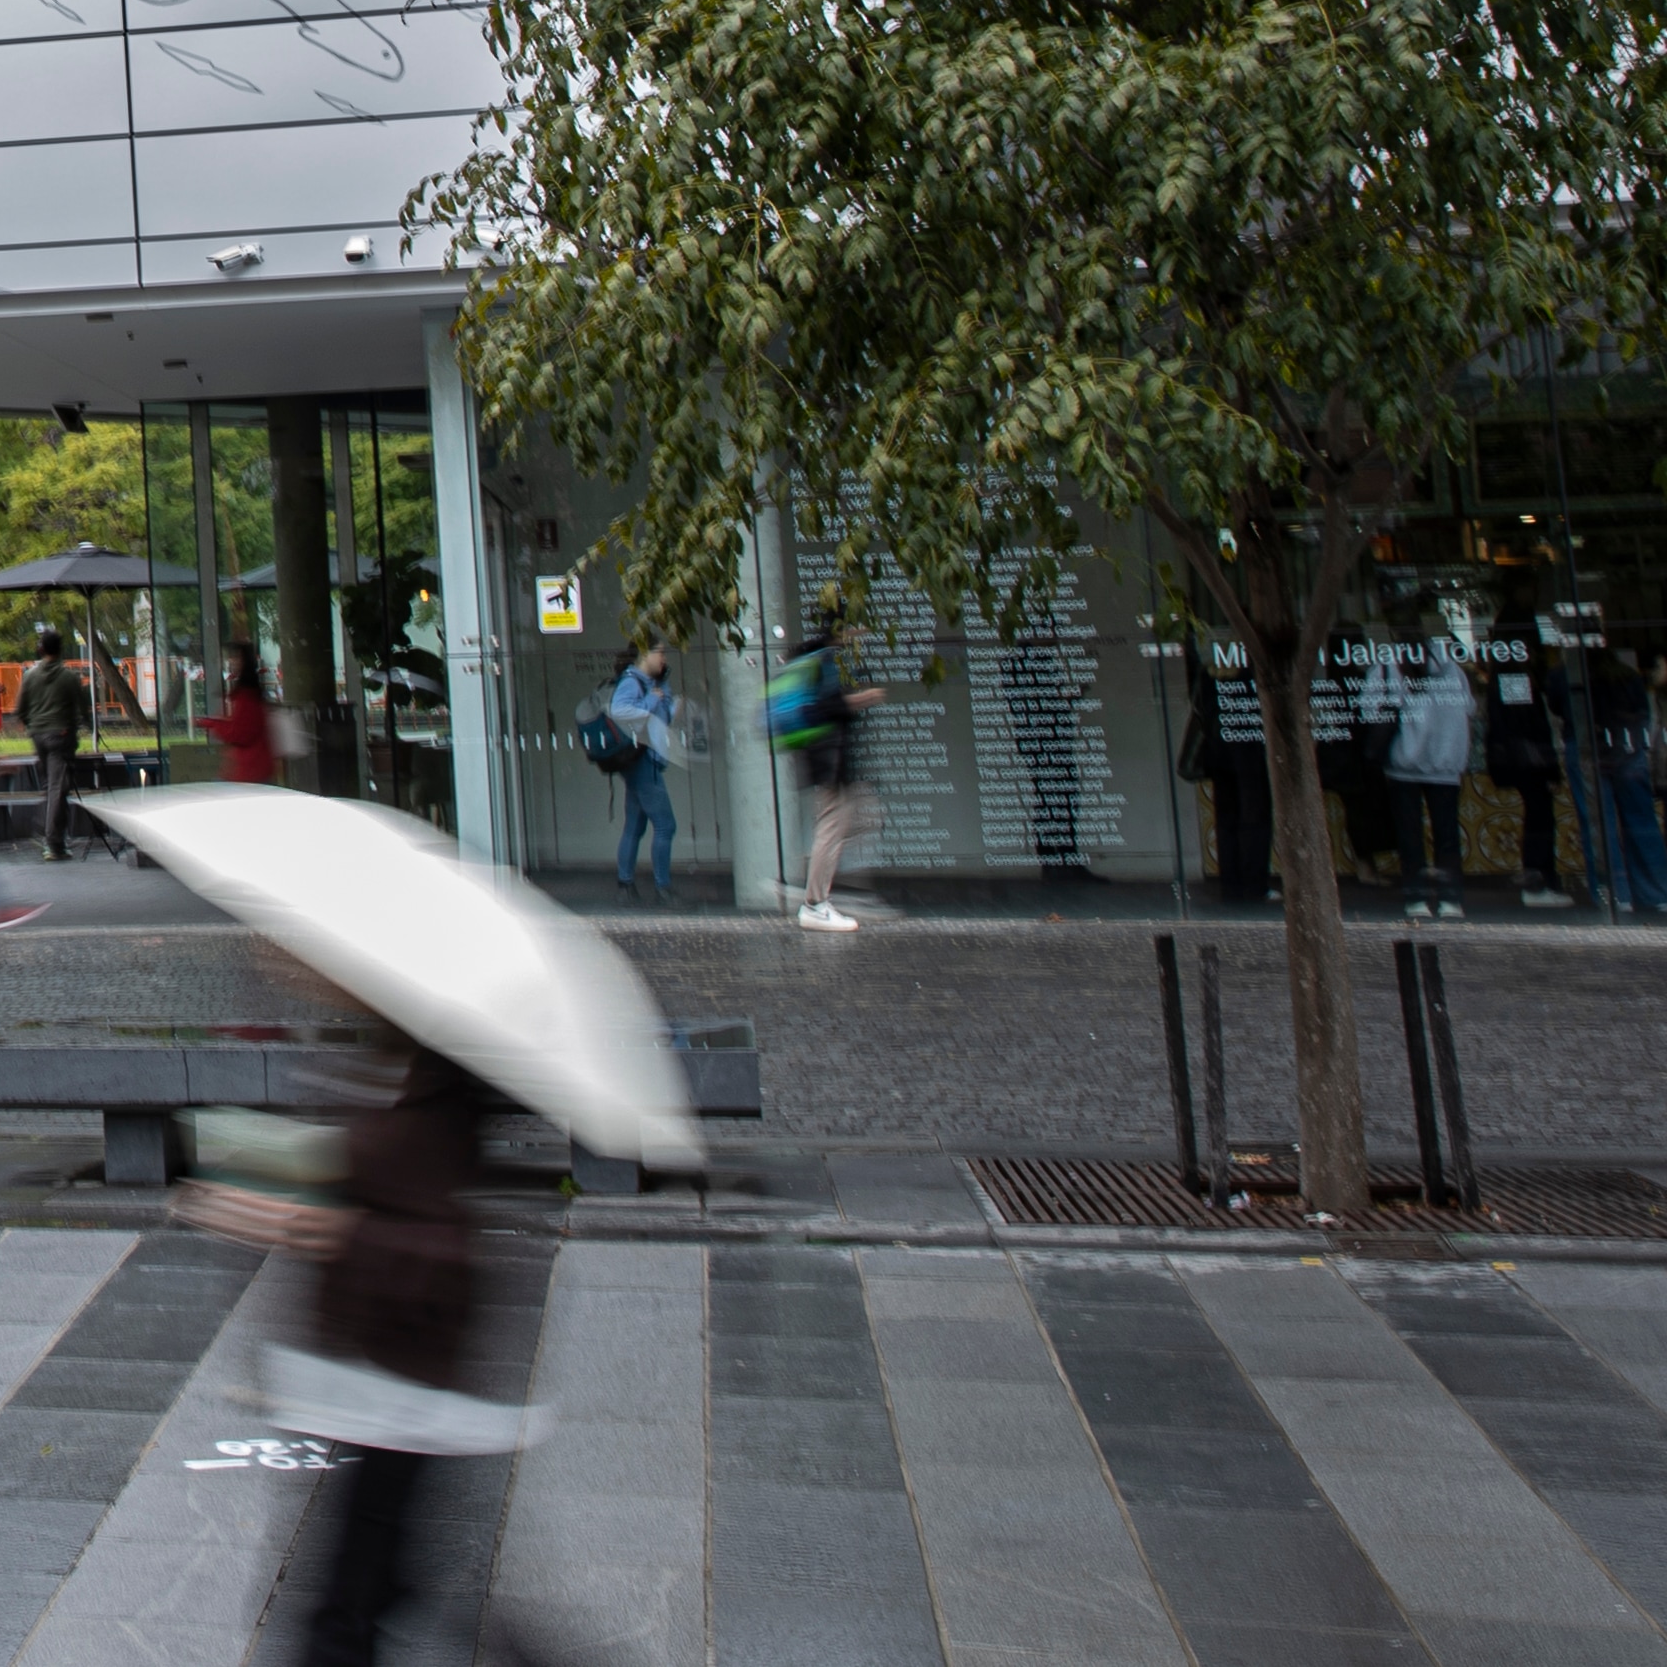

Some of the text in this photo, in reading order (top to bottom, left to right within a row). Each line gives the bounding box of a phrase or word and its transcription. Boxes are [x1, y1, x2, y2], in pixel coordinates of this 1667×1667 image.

[966, 644, 1085, 659] Knowledge grows from
[1334, 638, 1425, 667] Jalaru
[1431, 636, 1529, 663] Torres
[995, 687, 1059, 699] experiences
[1216, 680, 1246, 694] born
[984, 853, 1091, 866] Commissioned 2021
